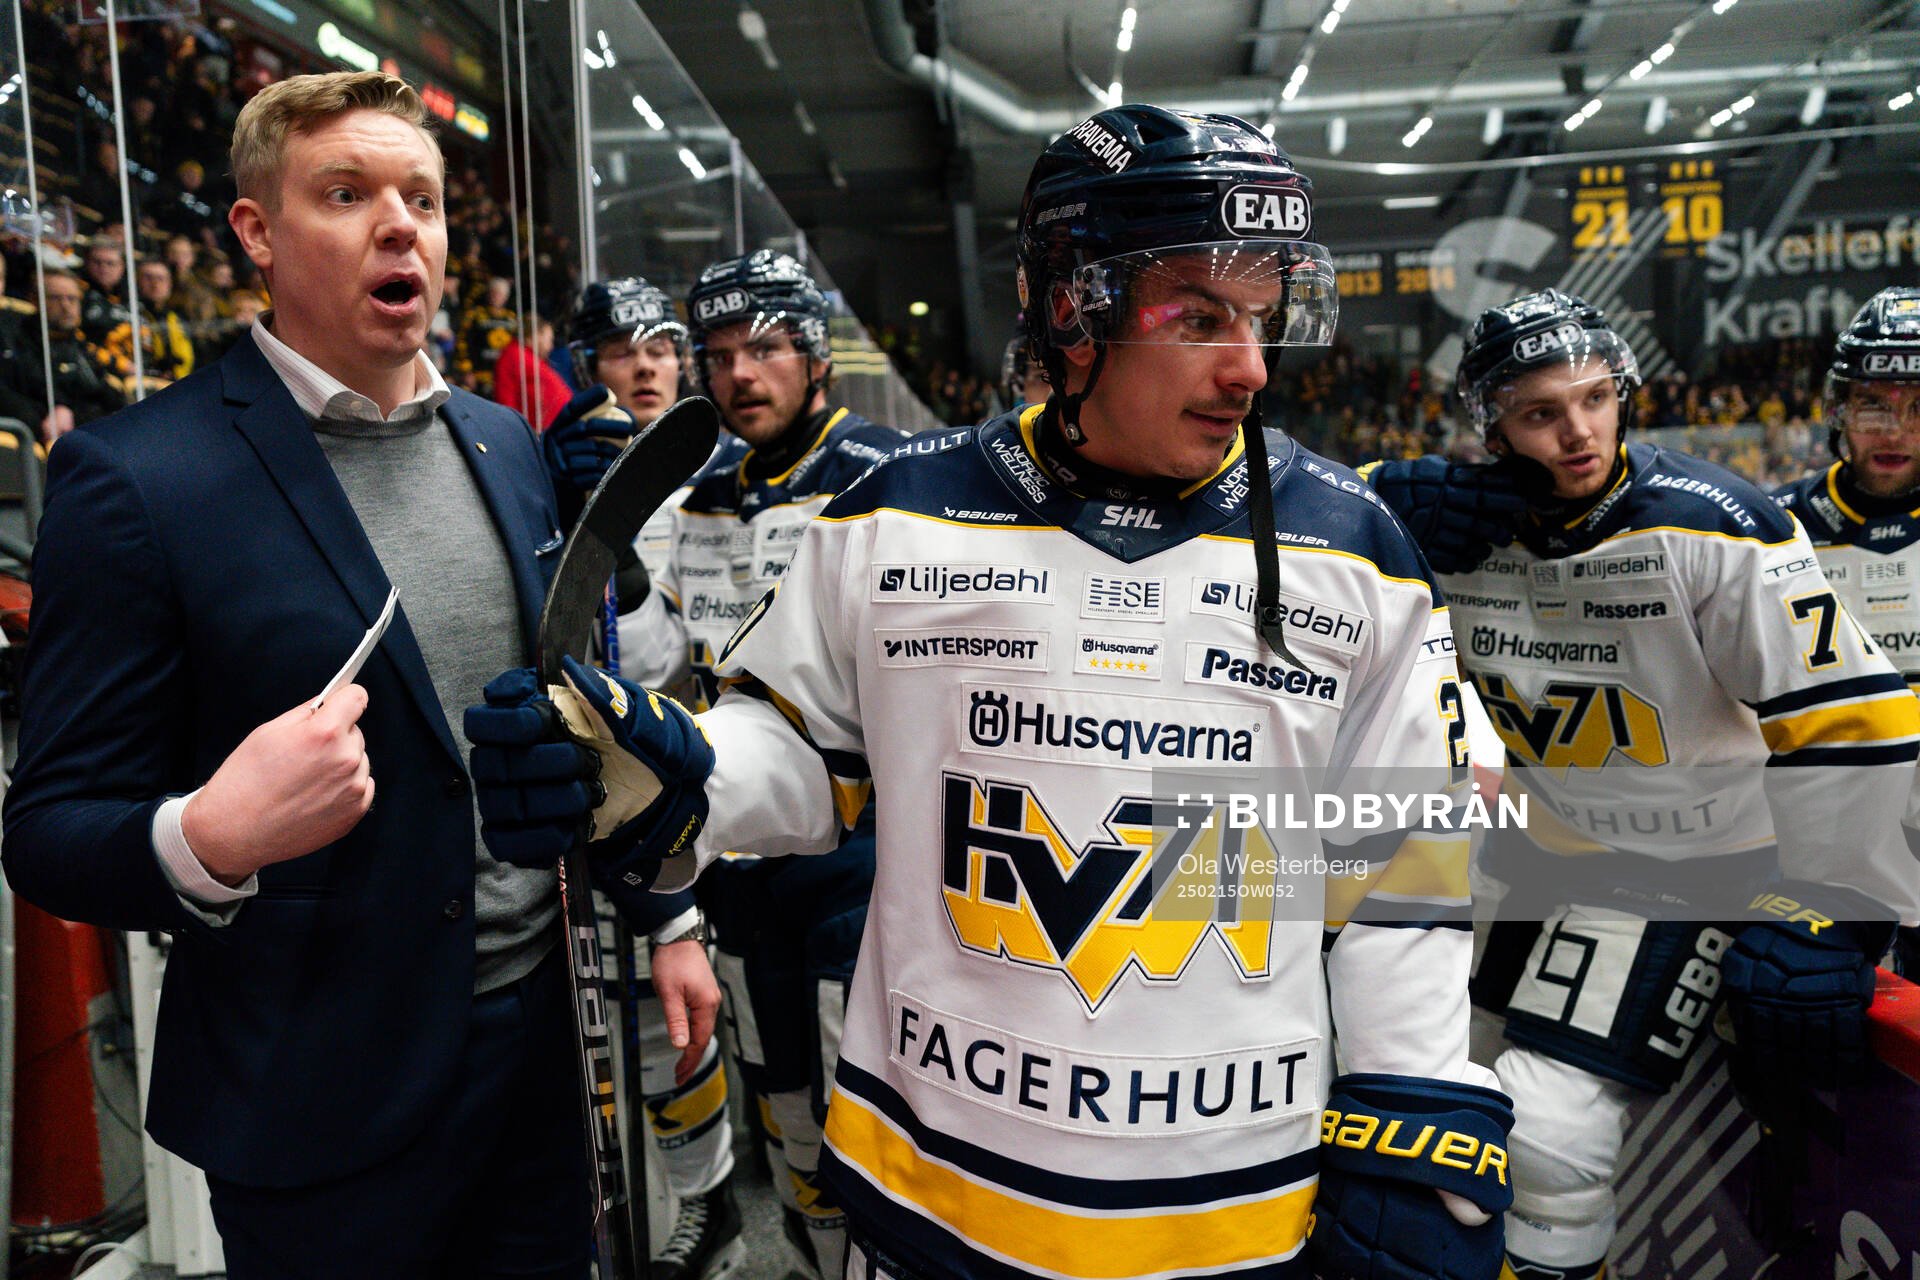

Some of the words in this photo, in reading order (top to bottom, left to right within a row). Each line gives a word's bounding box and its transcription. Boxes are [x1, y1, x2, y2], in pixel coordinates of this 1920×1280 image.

[1234, 193, 1306, 230] EAB
[1571, 200, 1631, 249] 21
[1661, 194, 1723, 243] 10
[1703, 215, 1920, 283] Skellef
[616, 304, 660, 324] EAB
[699, 291, 744, 319] EAB
[1519, 324, 1580, 359] EAB
[991, 438, 1047, 504] WELLNESS
[1009, 444, 1050, 488] NORDIC
[1100, 505, 1163, 530] SHL
[1647, 473, 1756, 528] FAGERHULT
[1275, 532, 1329, 548] AUER
[1089, 578, 1160, 608] HSE
[1583, 600, 1668, 619] Passera
[904, 636, 1039, 659] INTERSPORT
[1094, 641, 1155, 656] Husqvarna
[1498, 632, 1619, 664] Husqvarna
[1201, 647, 1338, 701] Passera
[1012, 701, 1253, 763] Husqvarna
[899, 1005, 1308, 1126] FAGERHULT
